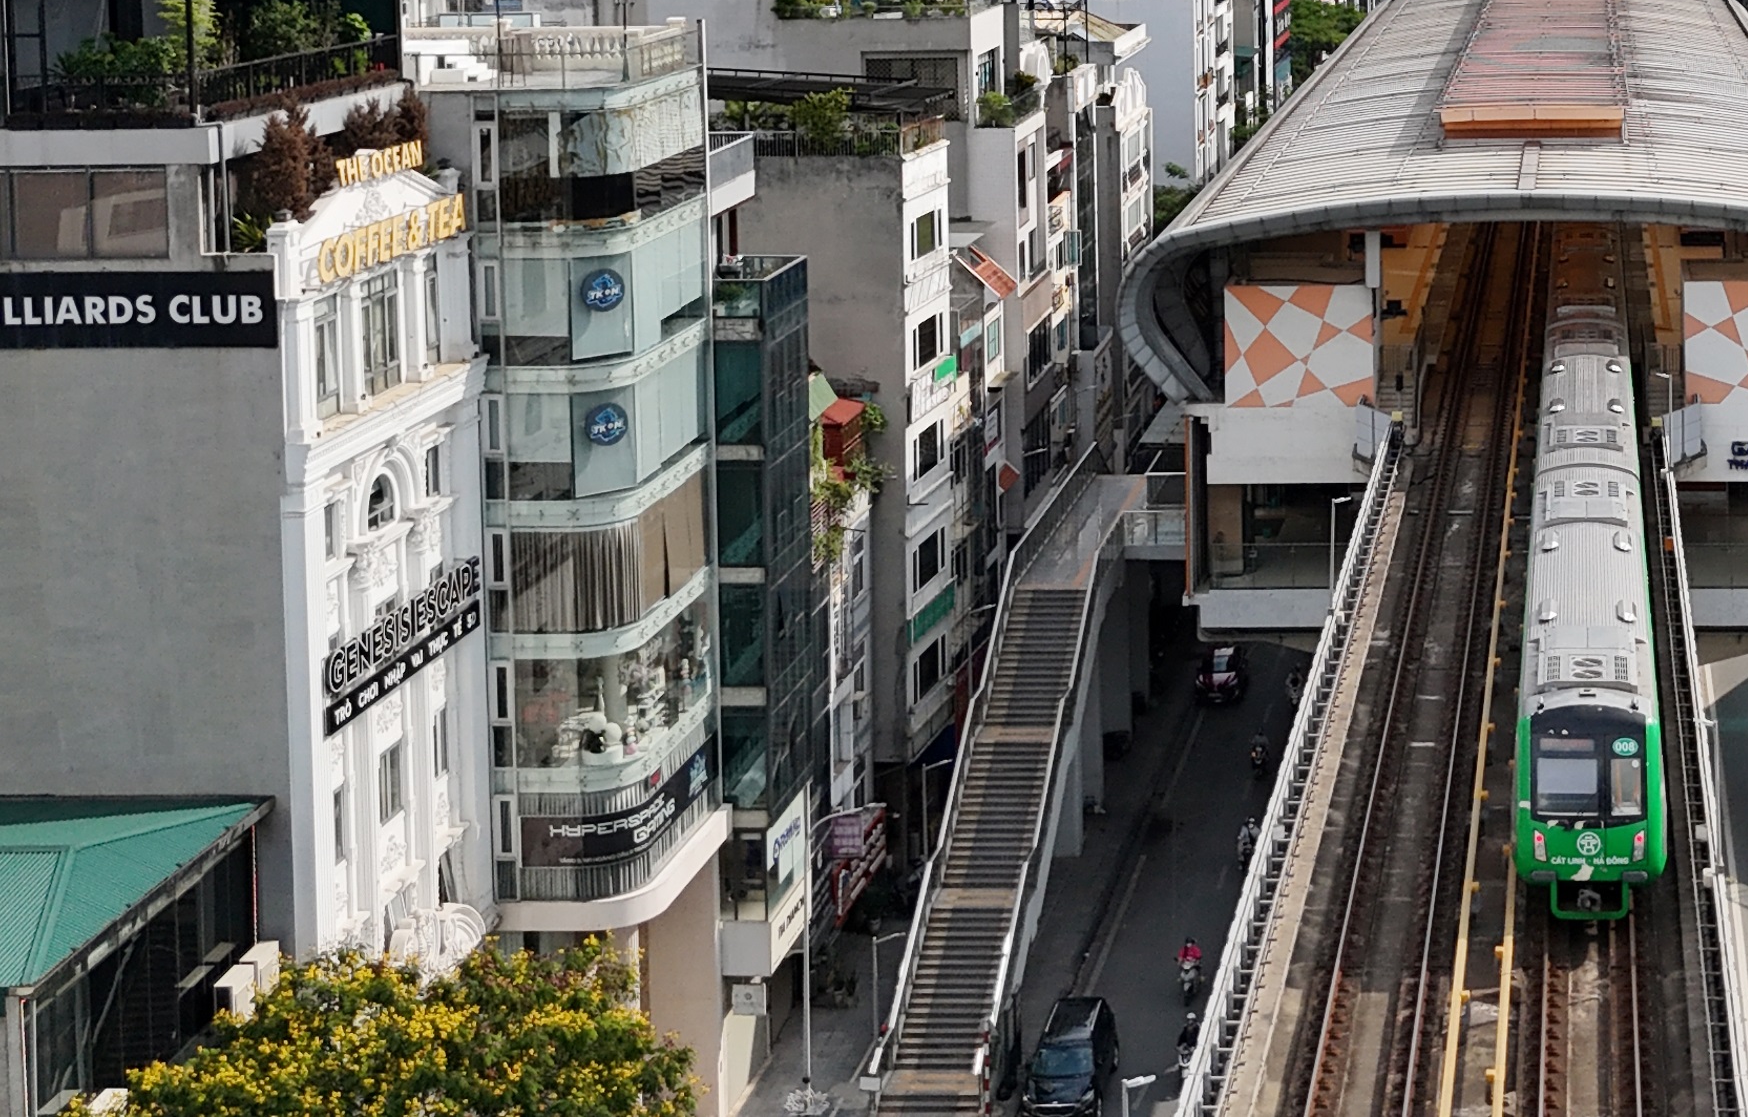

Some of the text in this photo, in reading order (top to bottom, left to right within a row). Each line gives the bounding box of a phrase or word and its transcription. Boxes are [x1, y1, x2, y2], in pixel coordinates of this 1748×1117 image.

[335, 140, 423, 187] THE OCEAN
[318, 193, 467, 284] COFFEE & TEA
[3, 294, 263, 325] LLIARDS CLUB
[327, 555, 480, 693] GENESIS ESCAPE
[334, 697, 352, 725] TRÒ
[1615, 742, 1635, 752] 008
[549, 792, 664, 837] HYPERSPACE
[633, 798, 675, 844] GAMING
[1551, 856, 1566, 865] CÁT
[1567, 857, 1586, 865] LINH
[1593, 856, 1604, 865] HÀ
[1606, 856, 1629, 865] ĐÔNG
